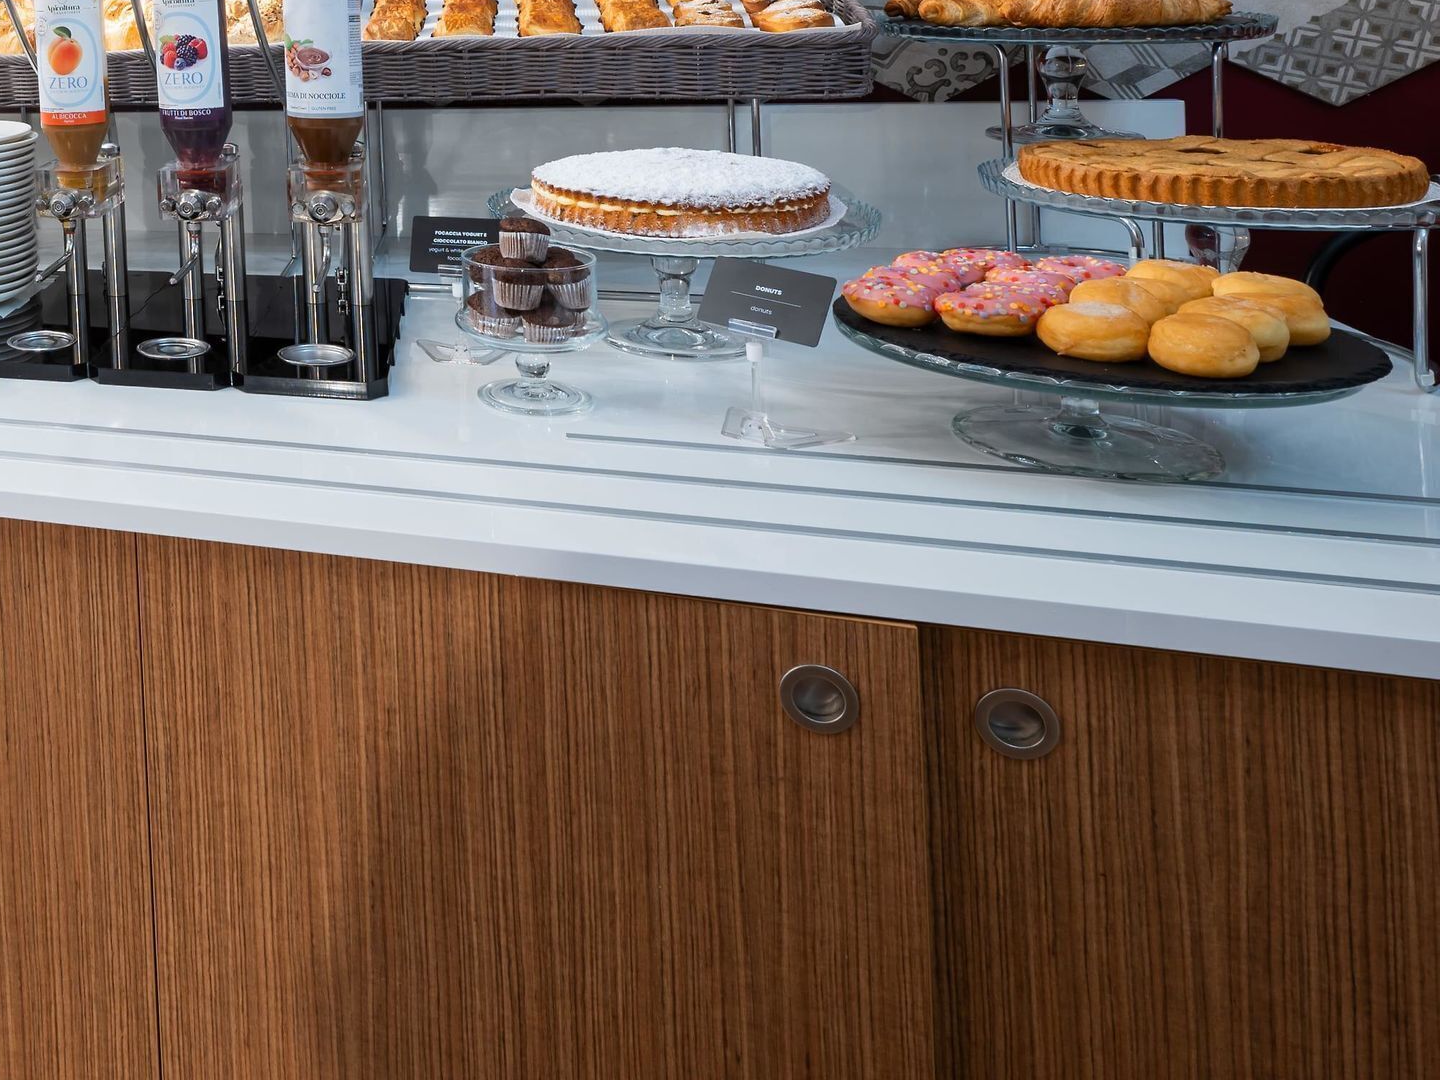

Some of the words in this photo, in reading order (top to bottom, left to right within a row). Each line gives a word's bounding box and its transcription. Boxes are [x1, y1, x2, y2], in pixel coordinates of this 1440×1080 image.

[49, 76, 88, 89] ZERO
[164, 71, 203, 85] ZERO
[308, 92, 346, 100] NOCCIOLE
[755, 285, 782, 296] DONUTS
[750, 305, 773, 315] donuts
